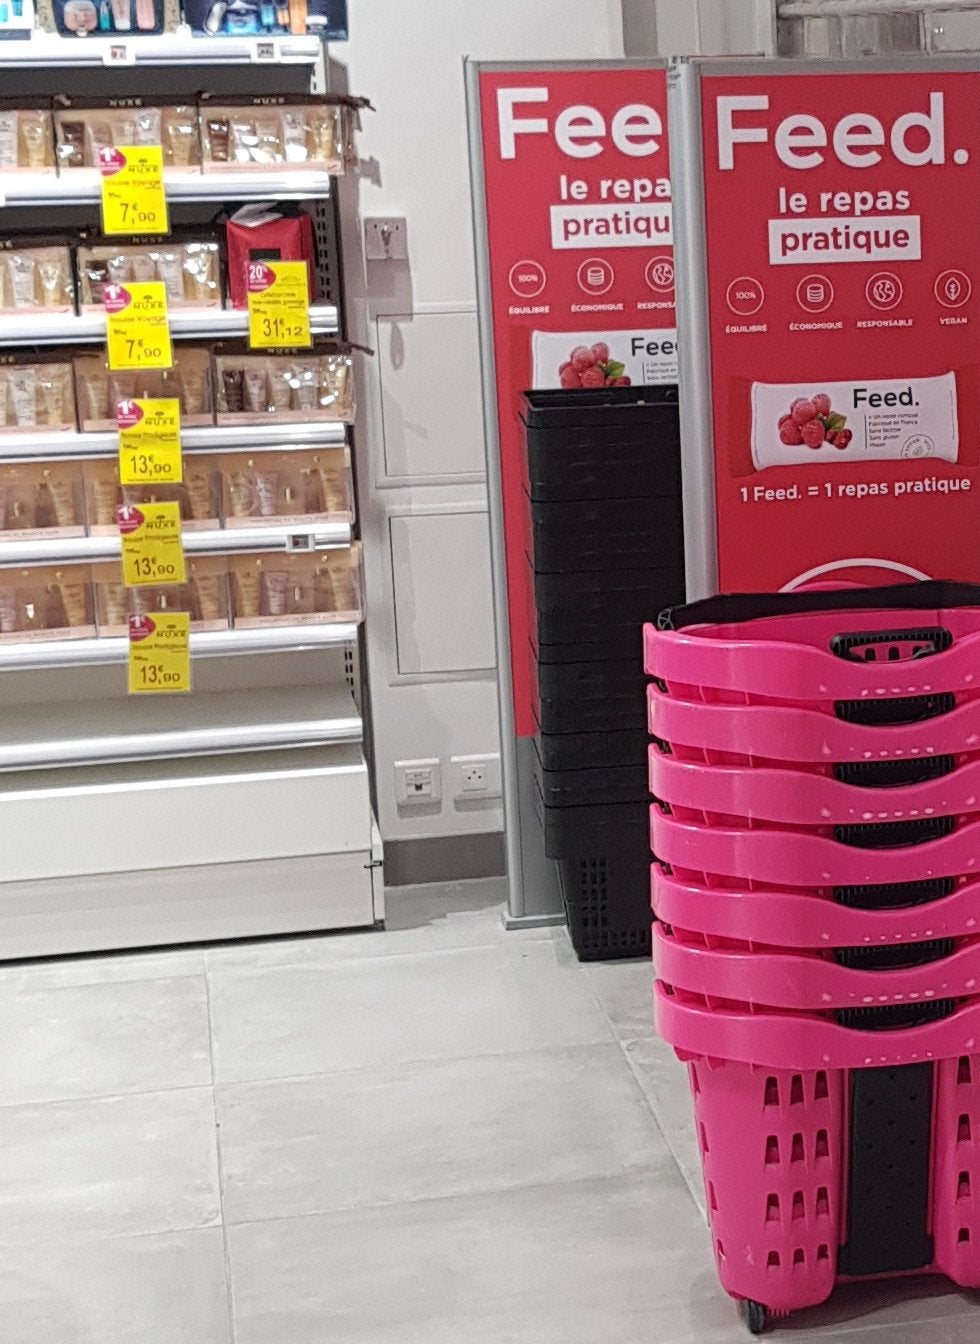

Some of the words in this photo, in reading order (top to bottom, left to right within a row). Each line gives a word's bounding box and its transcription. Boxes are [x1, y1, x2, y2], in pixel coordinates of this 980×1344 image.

[496, 86, 663, 160] Fee
[715, 90, 970, 170] Feed.
[559, 174, 589, 200] le
[600, 176, 672, 203] repa
[778, 186, 808, 214] le
[820, 189, 911, 216] repas
[563, 211, 671, 242] pratiqu
[780, 225, 910, 257] pratique
[735, 290, 757, 300] 100%
[856, 318, 914, 329] RESPONSABLE
[939, 316, 968, 326] VEGAN
[631, 337, 678, 357] Fee
[853, 386, 920, 409] Feed.
[740, 487, 748, 502] 1
[753, 484, 802, 501] Feed.
[807, 486, 820, 497] =
[824, 482, 832, 498] 1
[837, 479, 889, 498] repas
[894, 476, 971, 496] pratique
